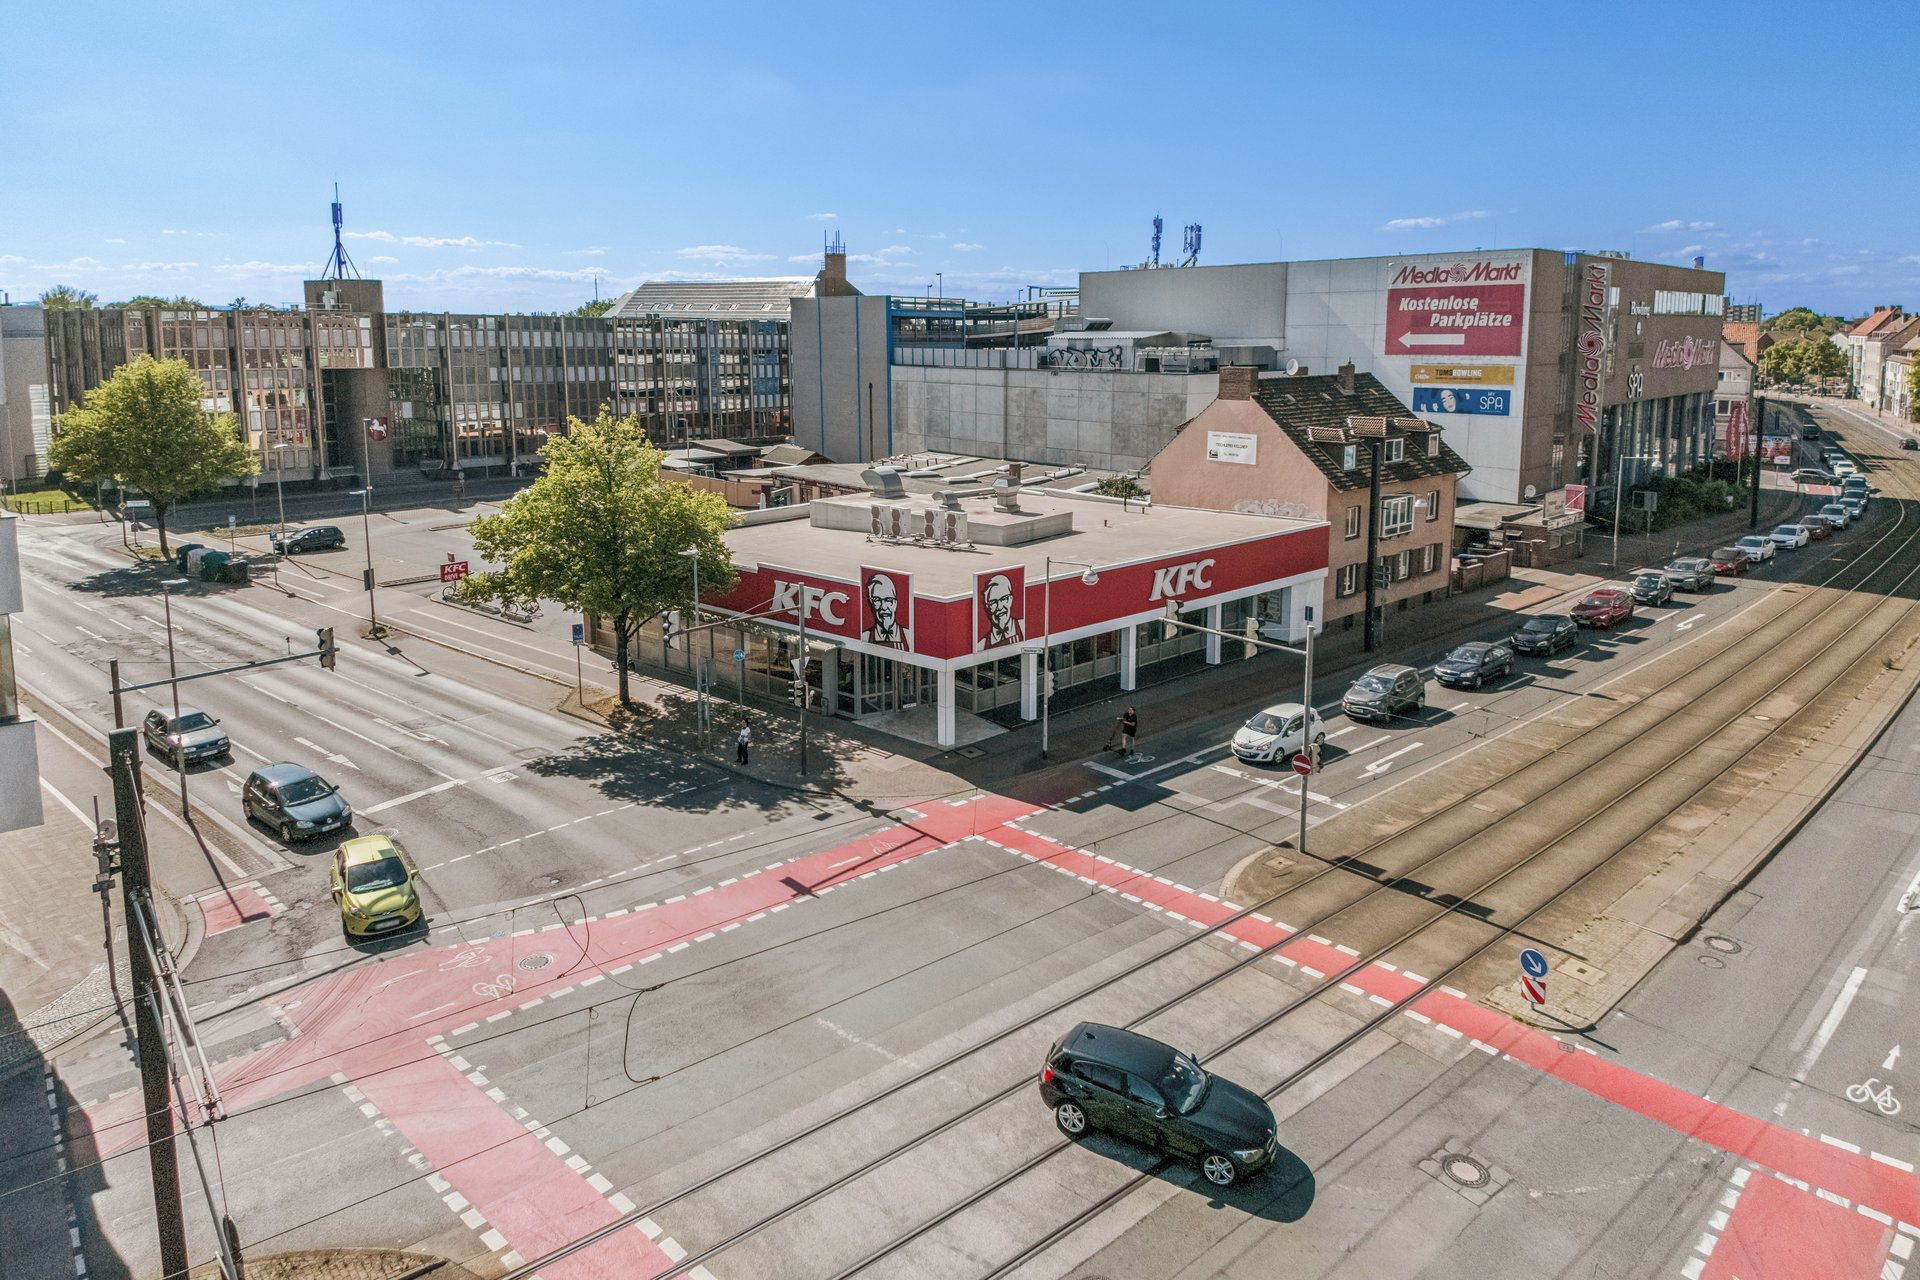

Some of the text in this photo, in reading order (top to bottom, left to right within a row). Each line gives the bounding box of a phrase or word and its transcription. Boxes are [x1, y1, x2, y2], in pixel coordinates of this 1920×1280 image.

[1392, 262, 1522, 285] Media Markt
[1399, 295, 1479, 312] Kostenlose
[1429, 311, 1512, 329] Parkplätze
[1575, 263, 1607, 433] Media Markt
[1628, 373, 1644, 399] SPA
[1479, 396, 1504, 411] SPA
[444, 562, 468, 574] KFC
[1148, 558, 1217, 601] KFC
[769, 580, 850, 626] KFC
